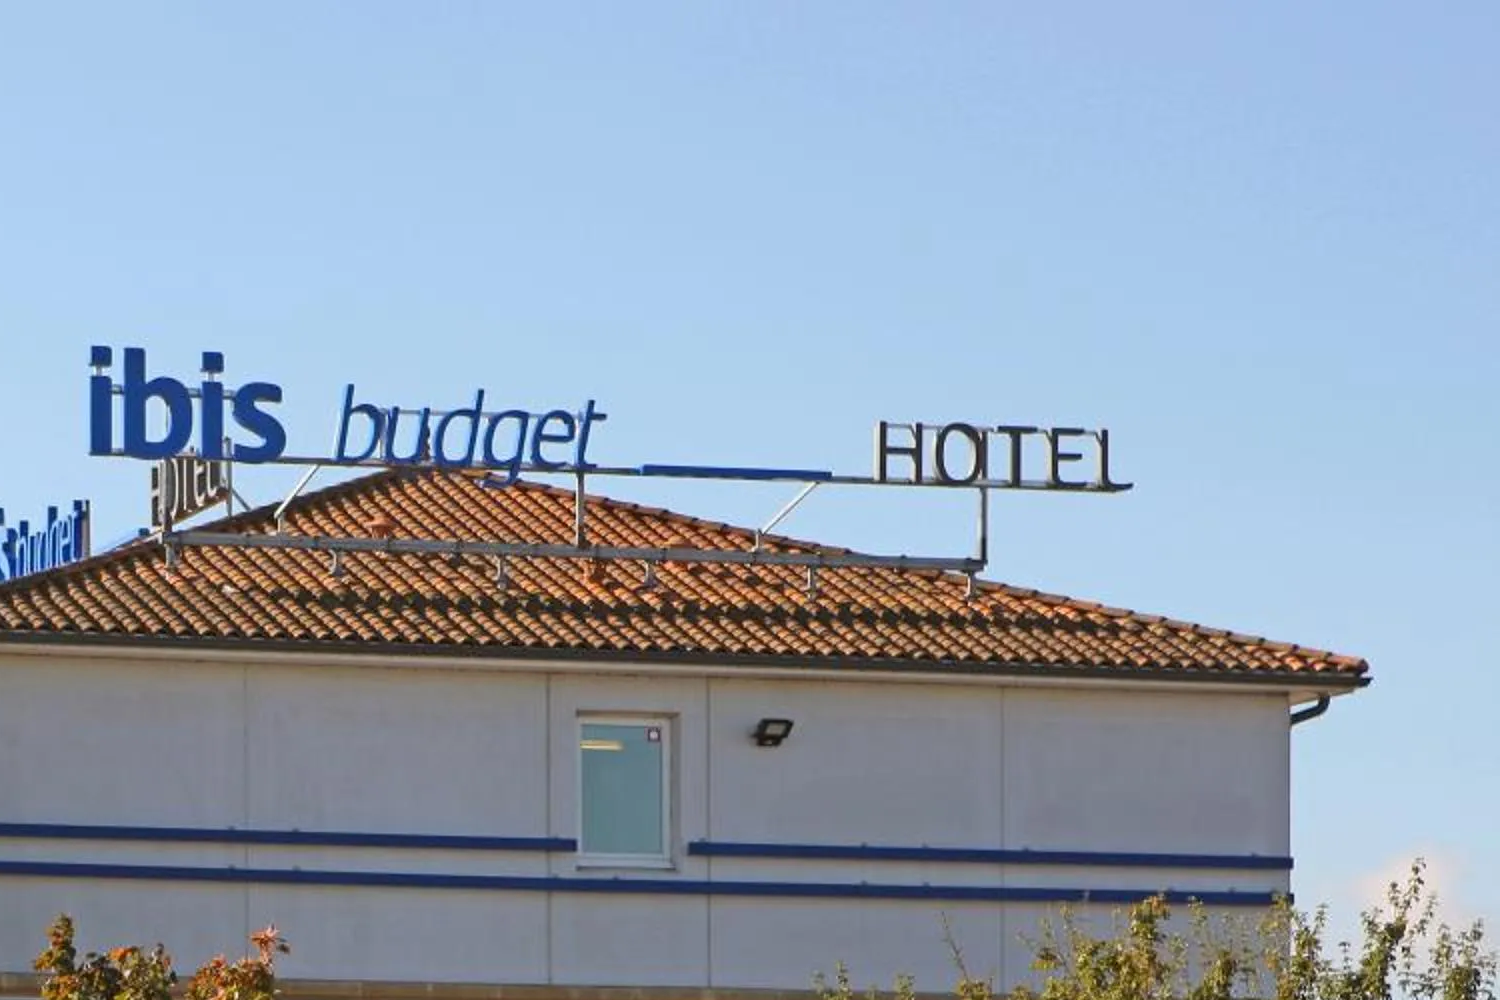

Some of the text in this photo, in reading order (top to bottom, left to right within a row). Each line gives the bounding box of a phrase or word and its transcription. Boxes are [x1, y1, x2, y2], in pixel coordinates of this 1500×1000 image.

[89, 345, 1133, 491] ibis budget HOTEL
